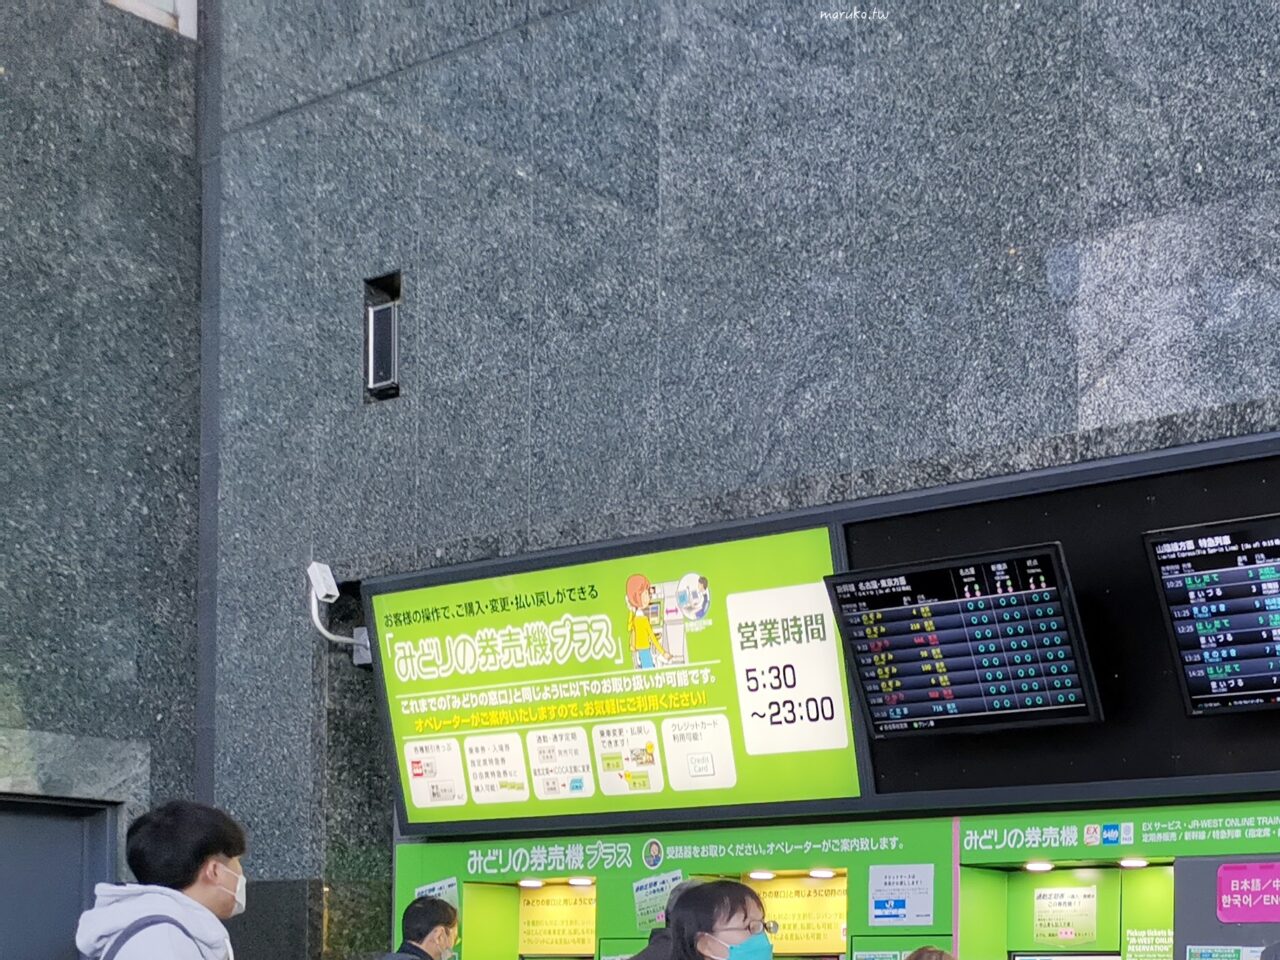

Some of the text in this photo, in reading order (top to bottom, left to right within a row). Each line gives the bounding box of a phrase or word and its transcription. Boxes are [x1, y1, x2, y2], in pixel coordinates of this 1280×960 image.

[385, 613, 625, 681] 「みどりの券売機プラス」
[737, 612, 827, 651] 営業時間
[745, 663, 797, 693] 5:30
[963, 823, 1079, 851] みどりの券売機
[1142, 822, 1152, 831] EX
[1225, 816, 1255, 827] ONLINE
[467, 841, 633, 875] みどりの券売機プラス
